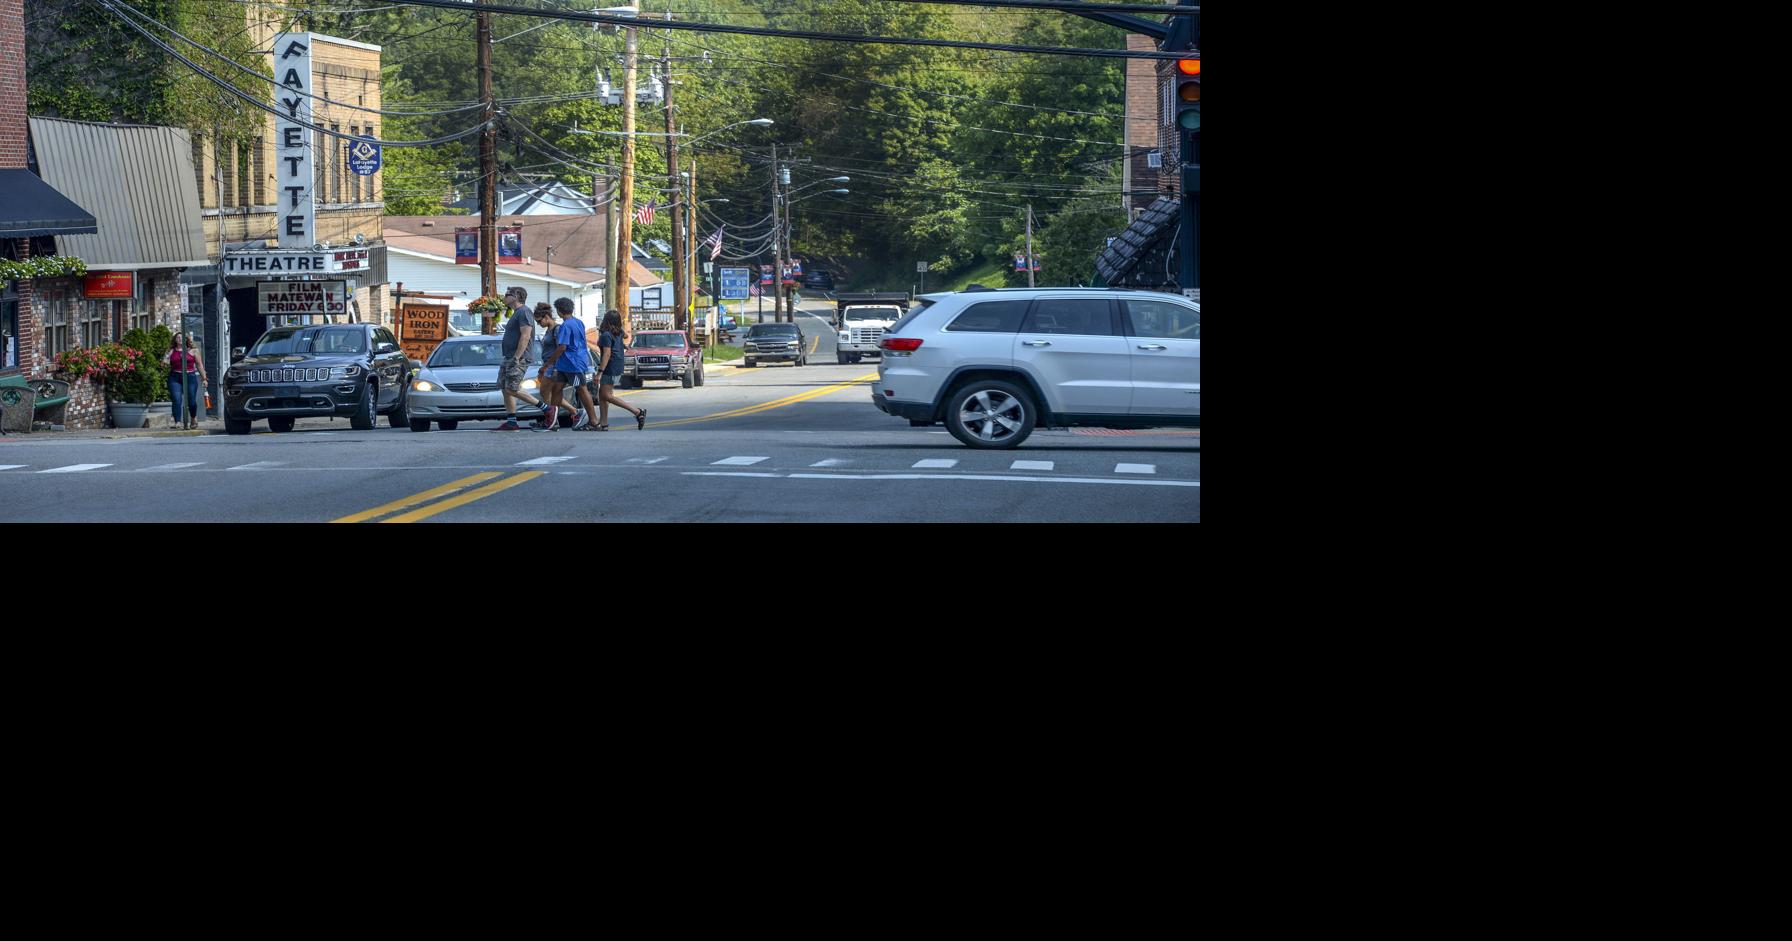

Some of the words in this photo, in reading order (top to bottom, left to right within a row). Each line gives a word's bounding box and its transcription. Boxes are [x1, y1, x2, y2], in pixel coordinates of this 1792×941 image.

[281, 40, 308, 236] FAYETTE
[225, 256, 325, 270] THEATRE
[288, 283, 322, 292] FILM
[267, 292, 334, 302] MATEWAN
[267, 302, 312, 312] FRIDAY
[407, 310, 445, 319] WOOD
[410, 320, 440, 329] IRON
